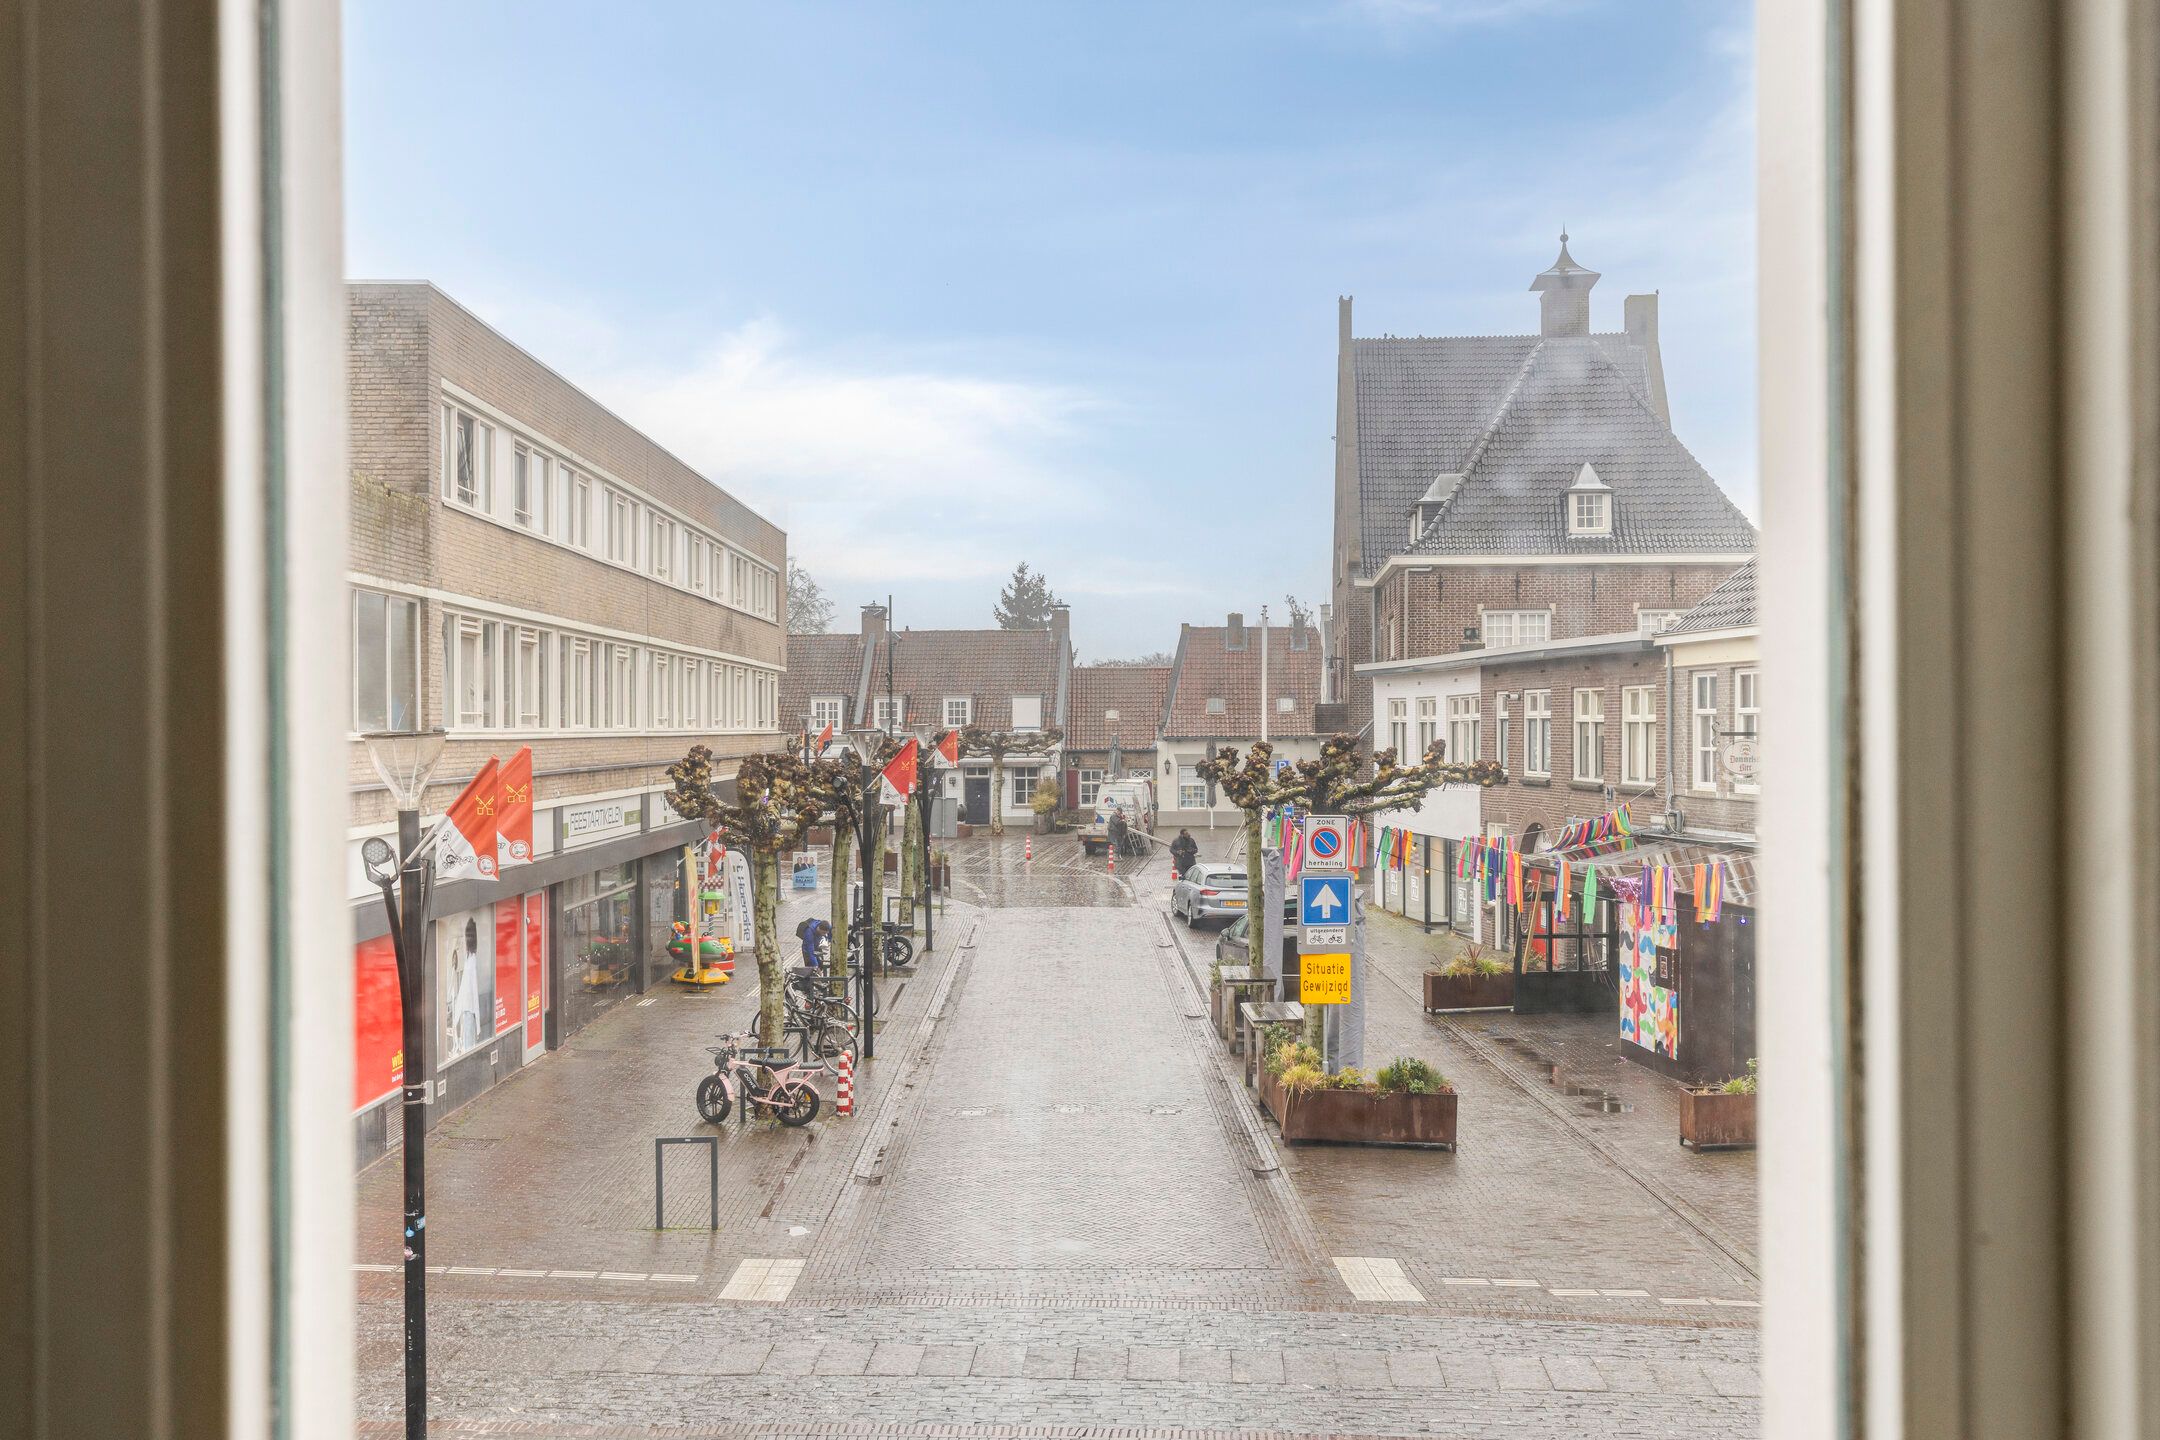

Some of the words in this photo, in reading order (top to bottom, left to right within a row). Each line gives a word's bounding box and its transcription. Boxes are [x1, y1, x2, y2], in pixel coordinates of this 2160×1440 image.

[569, 805, 623, 831] FEESTARTIKELEN
[1306, 962, 1345, 975] Situatie
[1303, 980, 1348, 995] Gewijzigd
